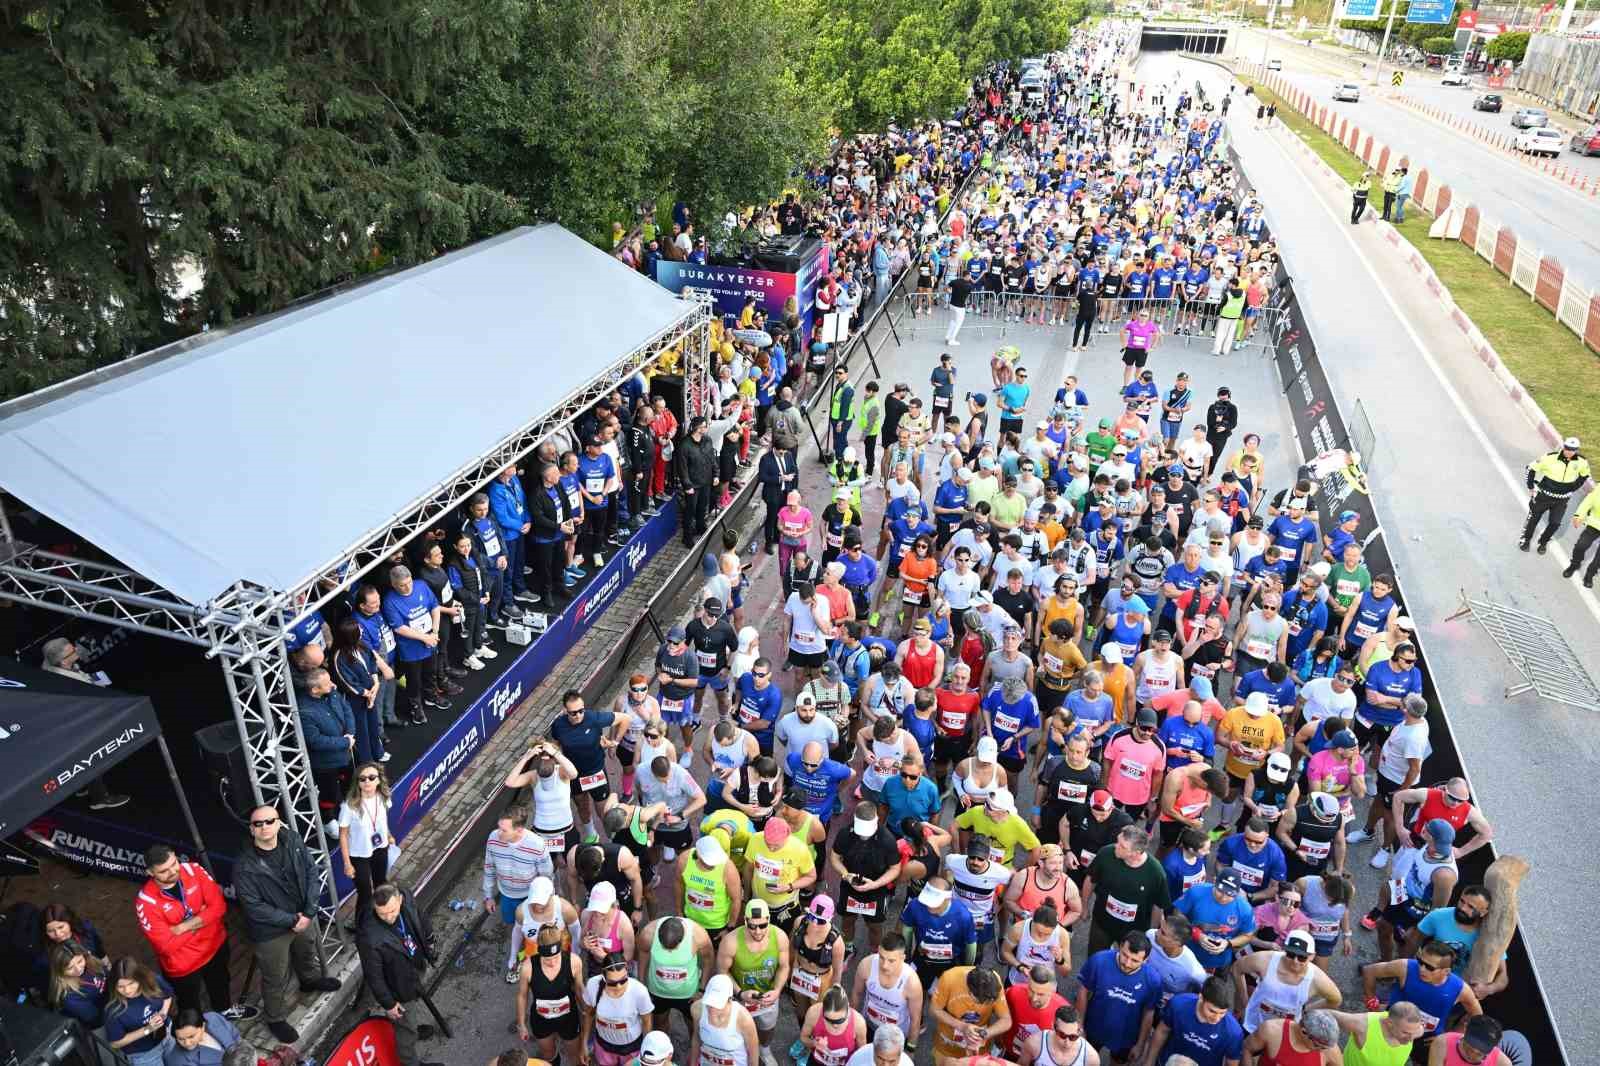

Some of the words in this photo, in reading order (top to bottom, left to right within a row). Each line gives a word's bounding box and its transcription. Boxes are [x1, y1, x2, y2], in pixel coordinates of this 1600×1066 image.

[57, 723, 144, 785] BAYTEKIN
[419, 726, 478, 797] RUNTALYA
[51, 829, 146, 867] RUNTALYA
[86, 856, 95, 866] by
[95, 859, 129, 873] Fraport
